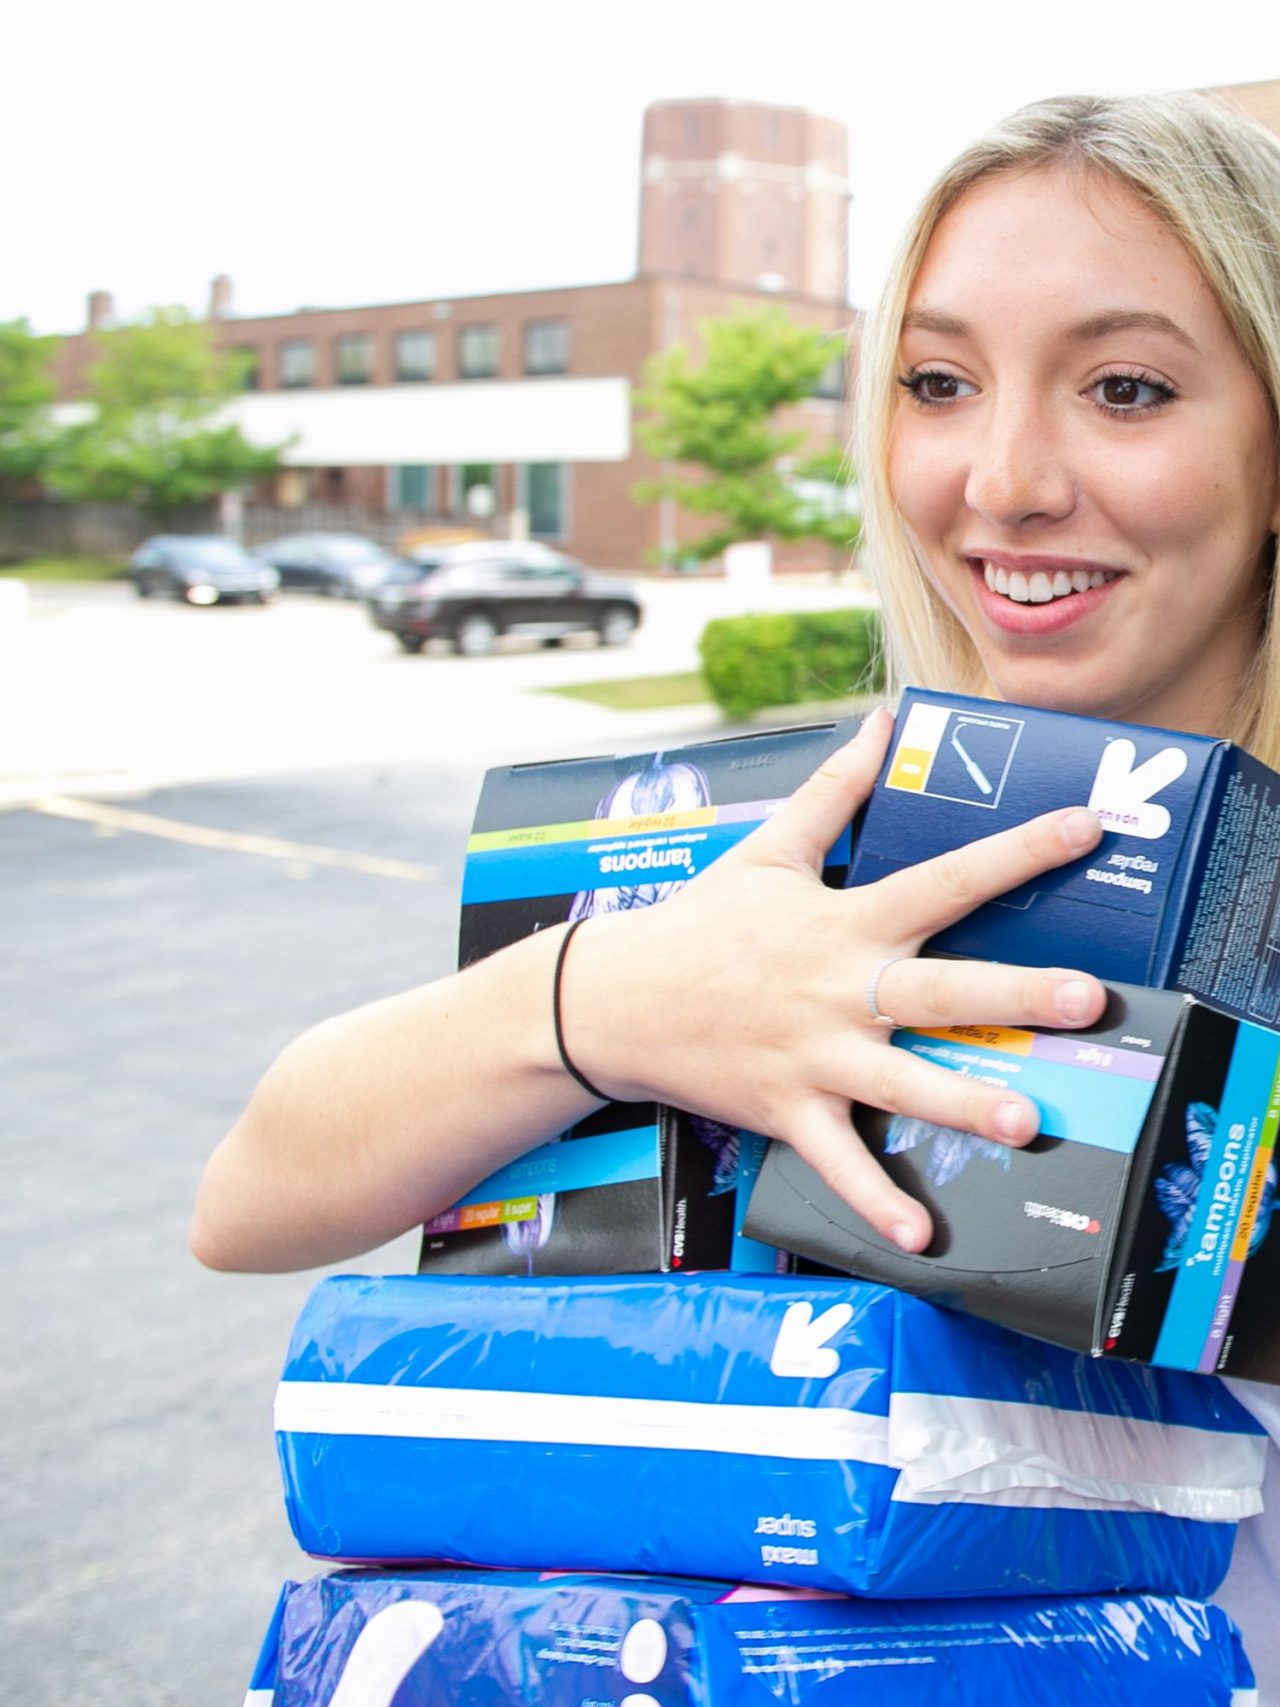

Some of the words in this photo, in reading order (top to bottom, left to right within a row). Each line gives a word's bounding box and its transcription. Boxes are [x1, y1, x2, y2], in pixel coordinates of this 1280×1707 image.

[599, 847, 693, 873] tampons
[1107, 854, 1158, 873] regular
[1085, 868, 1153, 894] tampons
[1188, 1122, 1246, 1266] tampons
[1211, 1218, 1234, 1277] multipack
[1225, 1176, 1245, 1217] plastic
[1236, 1114, 1260, 1175] applicator
[1243, 1167, 1266, 1219] regular
[1213, 1292, 1234, 1327] light
[754, 1513, 816, 1538] super
[761, 1545, 818, 1567] maxi
